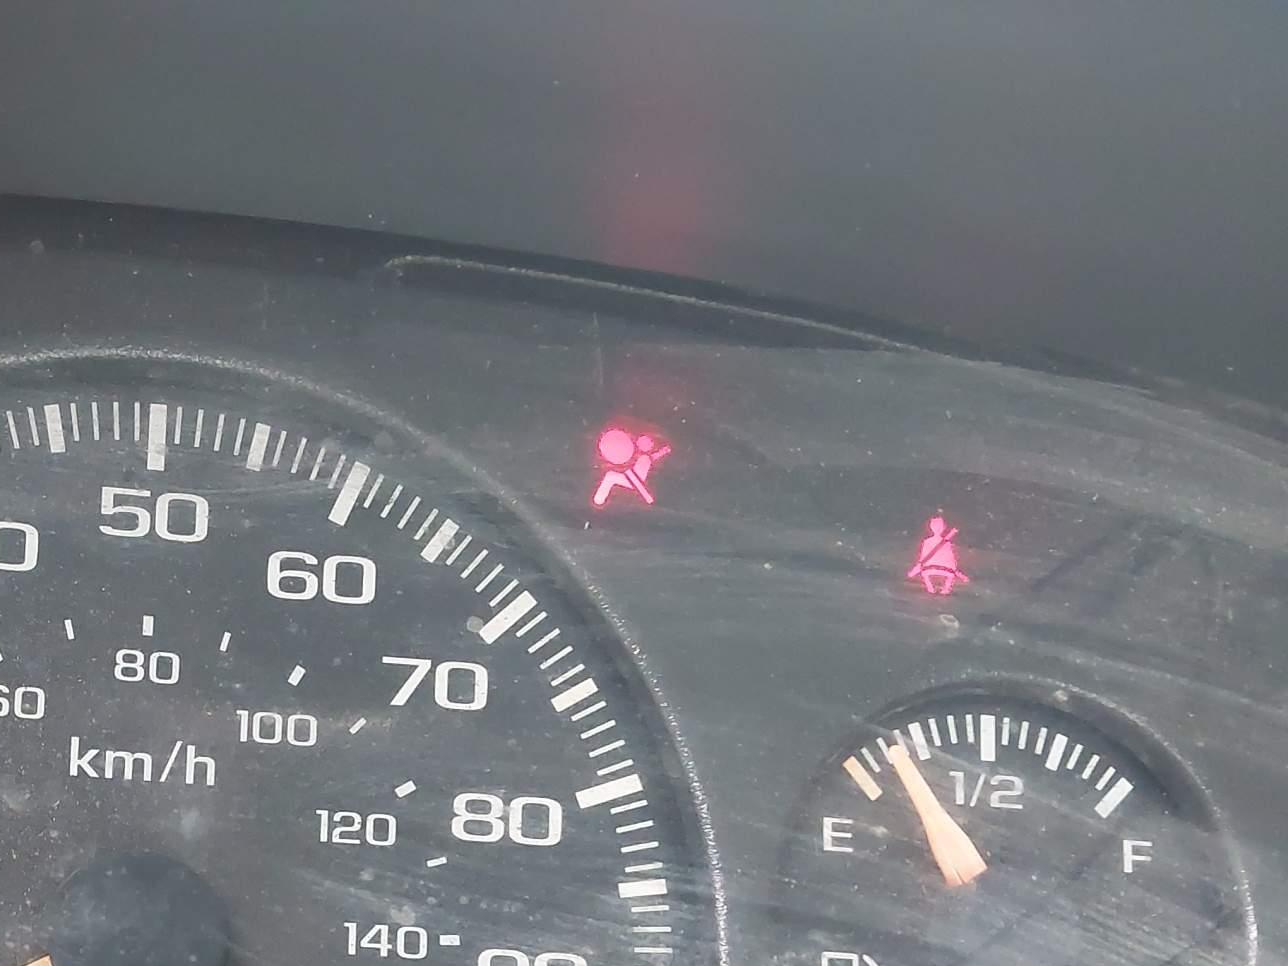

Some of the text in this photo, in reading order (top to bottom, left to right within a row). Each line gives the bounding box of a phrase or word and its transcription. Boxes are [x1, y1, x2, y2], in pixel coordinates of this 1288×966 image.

[99, 487, 209, 543] 50
[267, 551, 377, 605] 60
[113, 649, 181, 685] 80
[381, 656, 489, 711] 70
[236, 710, 318, 747] 100
[69, 736, 216, 786] km/h
[949, 770, 1024, 810] 1/2
[315, 809, 397, 847] 120
[450, 793, 563, 847] 80
[822, 816, 854, 854] E
[1123, 839, 1153, 873] F
[343, 921, 429, 960] 140
